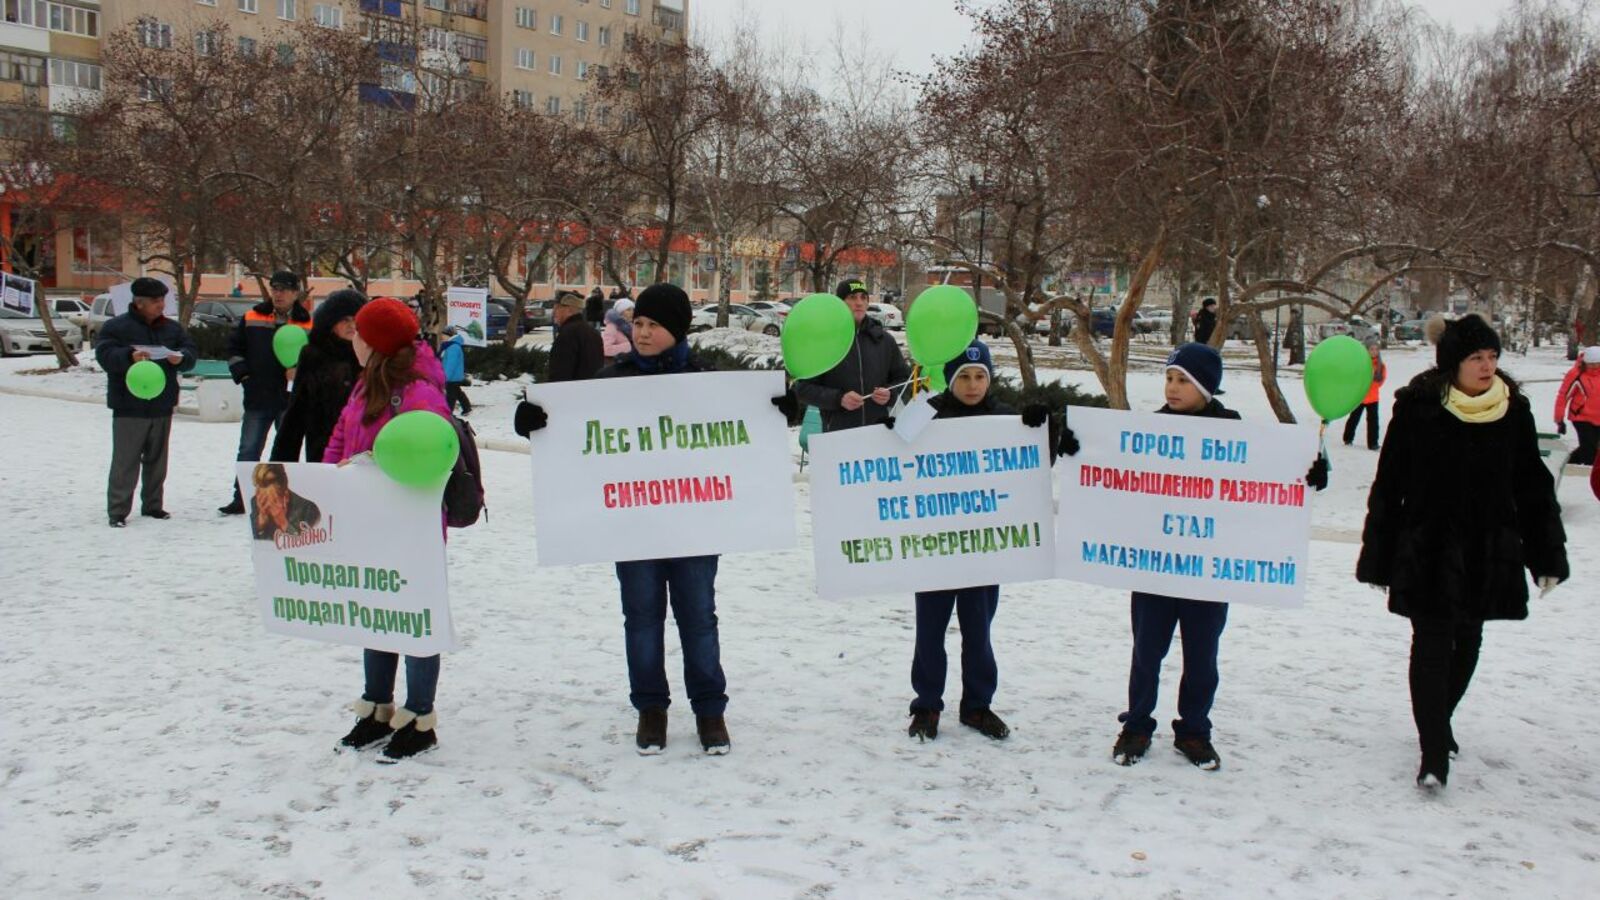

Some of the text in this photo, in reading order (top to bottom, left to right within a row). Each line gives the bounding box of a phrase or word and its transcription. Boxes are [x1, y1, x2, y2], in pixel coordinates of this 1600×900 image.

[637, 426, 653, 452] и
[1119, 430, 1248, 464] ГОРОД БЫЛ
[982, 444, 1041, 473] ЗЕМЛИ
[603, 475, 733, 508] СИНОНИМЫ
[1079, 464, 1305, 507] ПРОМЫШЛЕННО РАЗВИТЫЙ
[877, 495, 911, 521] ВСЕ
[1162, 512, 1215, 539] СТАЛ
[840, 537, 893, 564] ЧЕРЕЗ
[1081, 541, 1297, 586] МАГАЗИНАМИ ЗАБИТЫЙ
[284, 556, 408, 593] Продал лес-
[273, 597, 432, 638] продал Родину!
